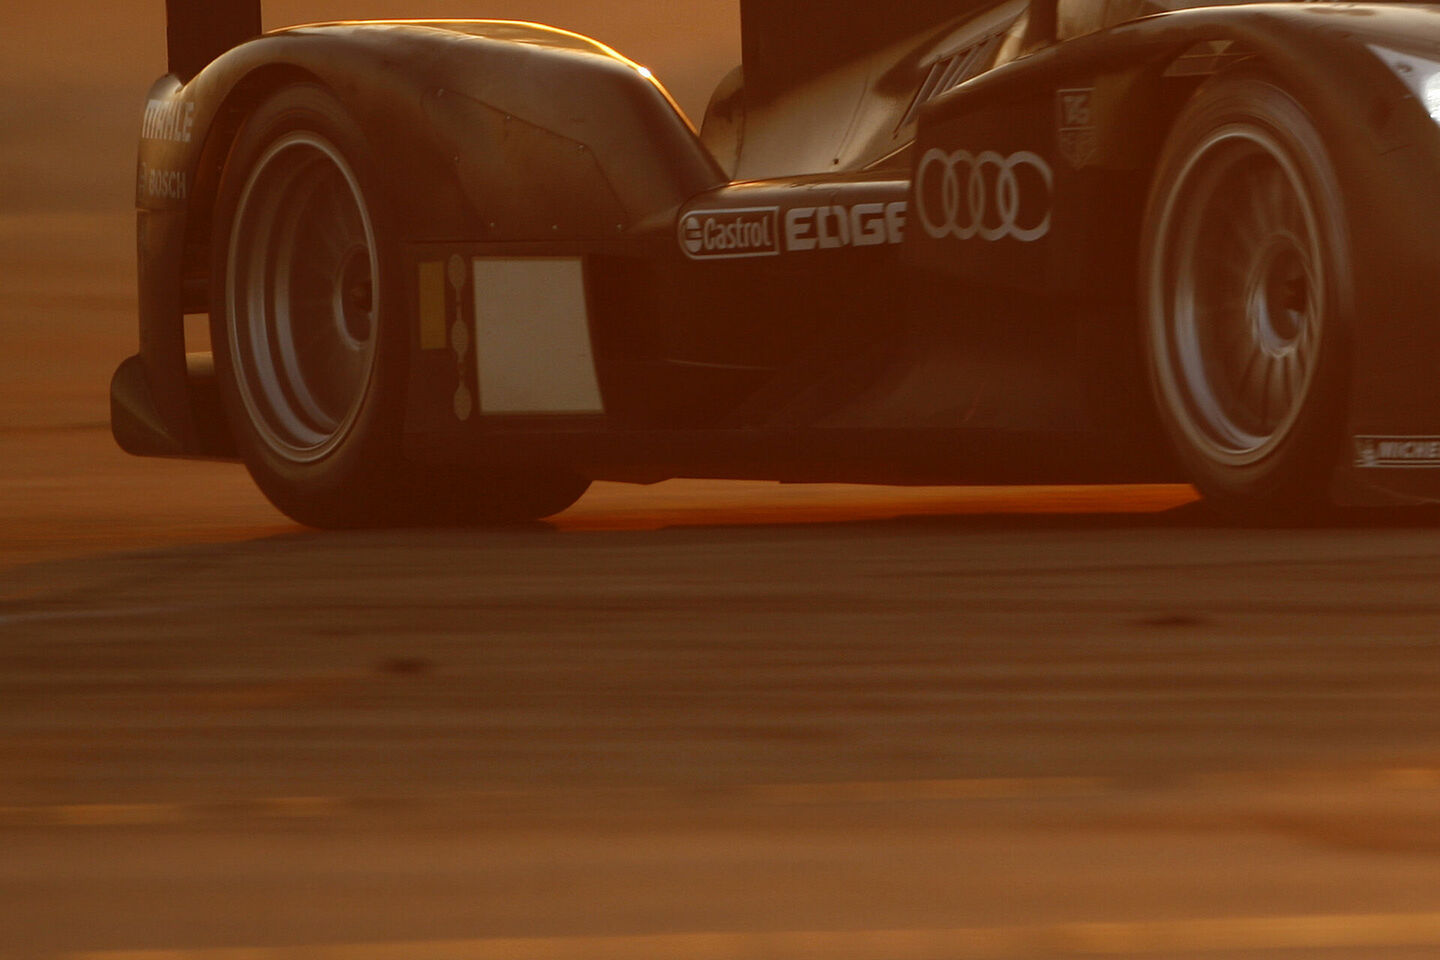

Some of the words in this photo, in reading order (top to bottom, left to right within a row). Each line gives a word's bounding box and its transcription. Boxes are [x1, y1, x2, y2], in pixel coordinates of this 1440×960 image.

[141, 98, 195, 143] MAHLE
[148, 167, 187, 200] BOSCH
[703, 214, 772, 251] Castrol
[785, 200, 908, 252] EDGE
